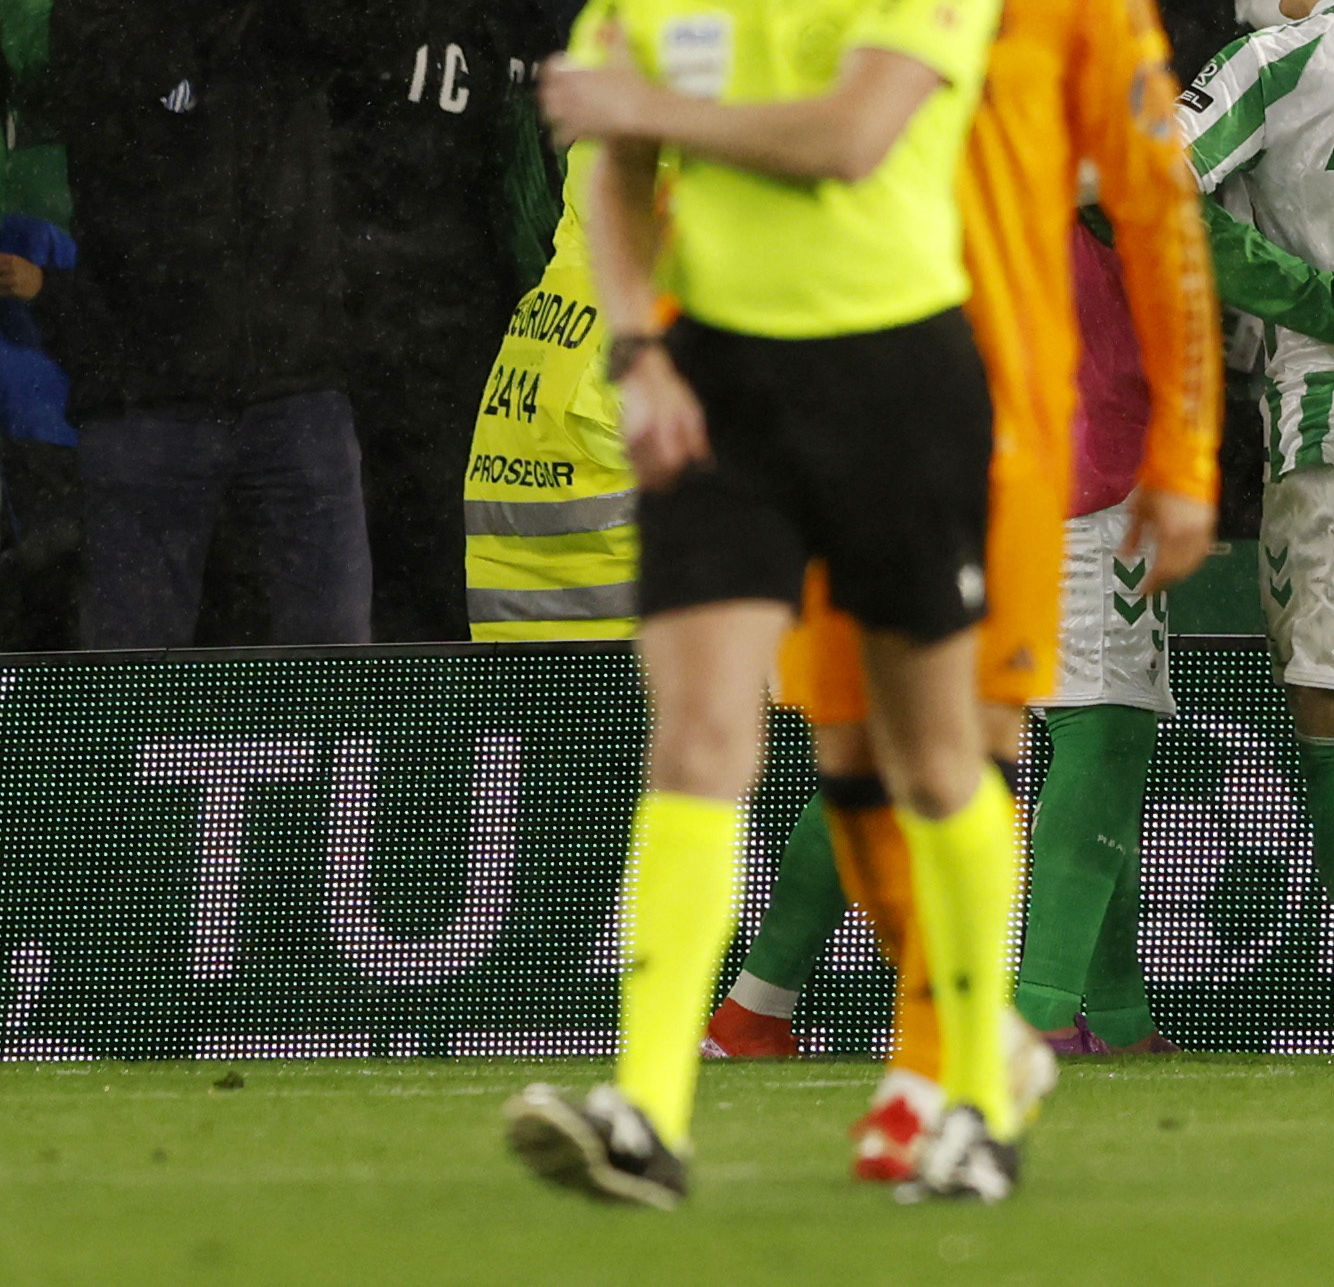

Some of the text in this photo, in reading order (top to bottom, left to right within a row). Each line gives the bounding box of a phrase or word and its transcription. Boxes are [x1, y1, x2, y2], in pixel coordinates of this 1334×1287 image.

[484, 365, 540, 424] 2414
[470, 455, 575, 488] PROSEGUR
[134, 730, 521, 986] TU
